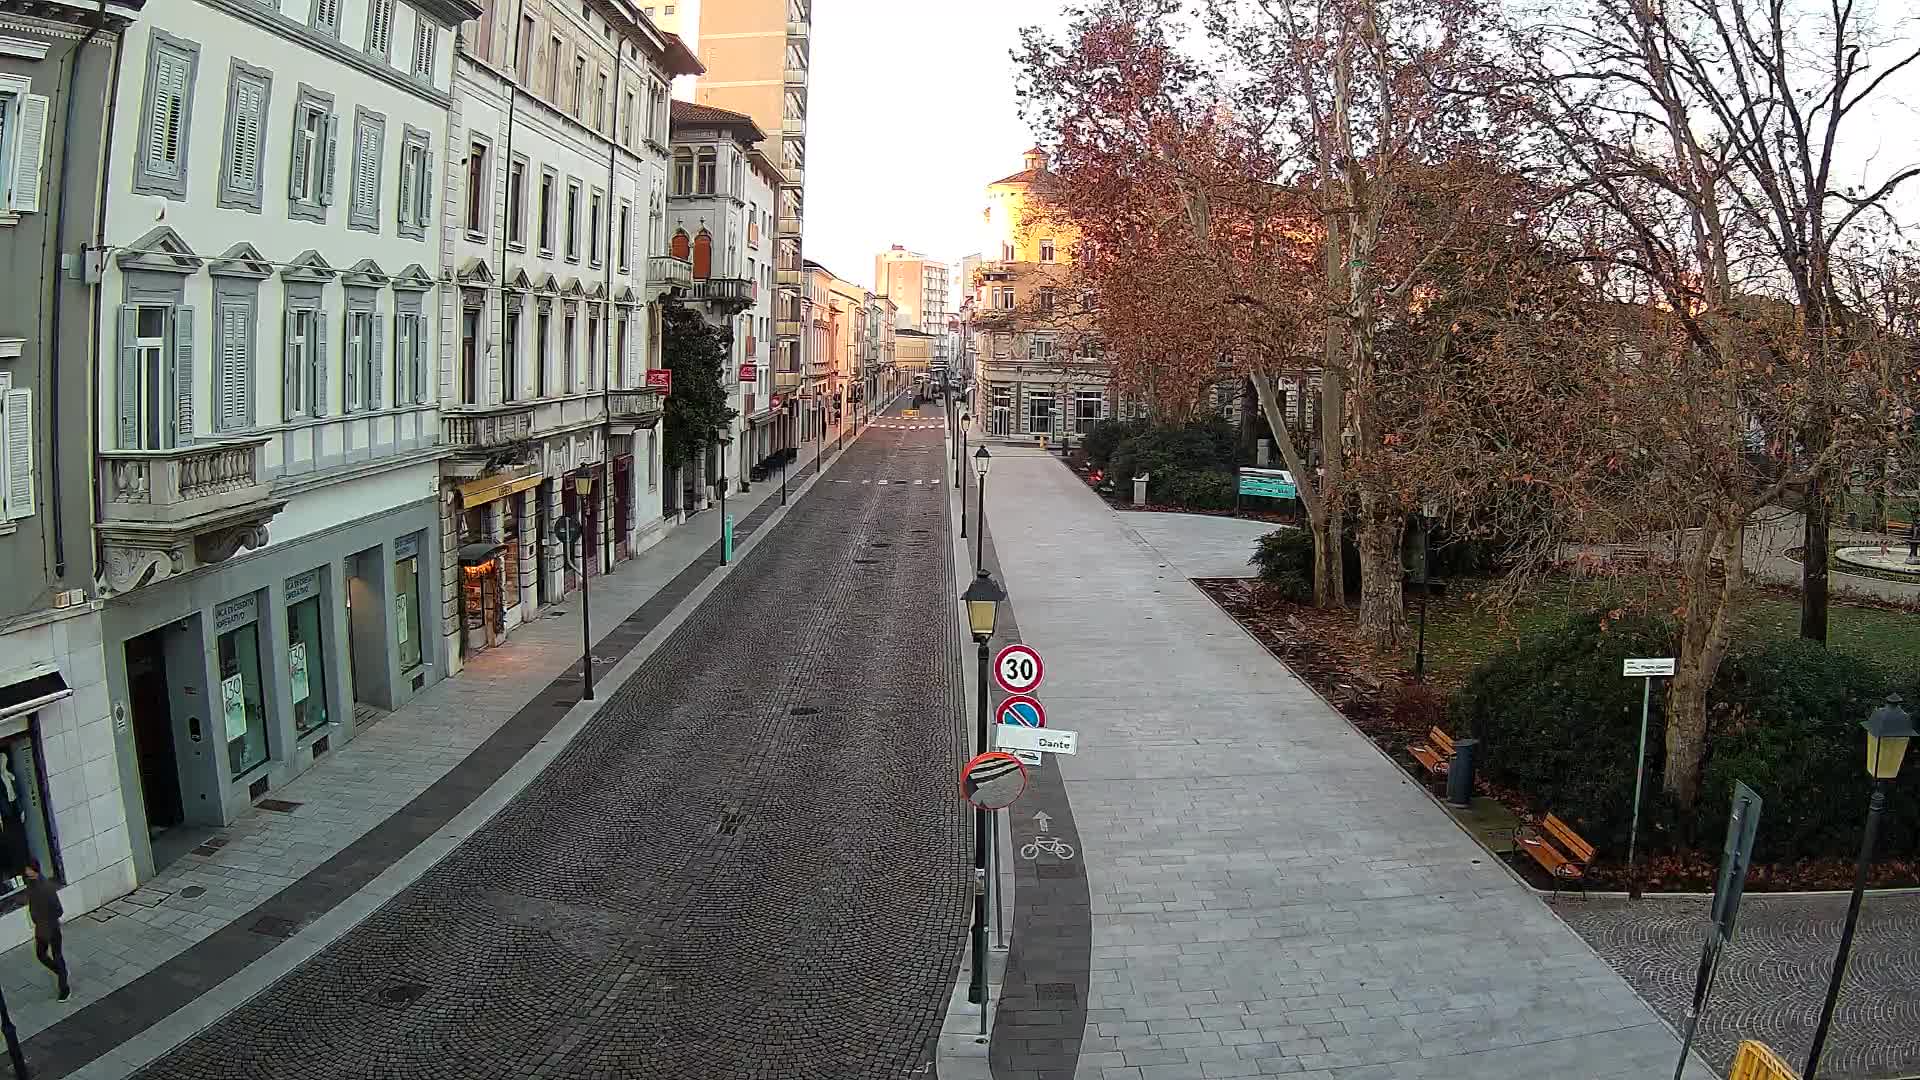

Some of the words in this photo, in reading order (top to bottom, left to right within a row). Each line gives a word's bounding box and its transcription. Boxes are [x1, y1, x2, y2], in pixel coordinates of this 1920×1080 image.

[1006, 659, 1033, 680] 30
[224, 678, 241, 700] 130
[1039, 738, 1070, 749] Dante
